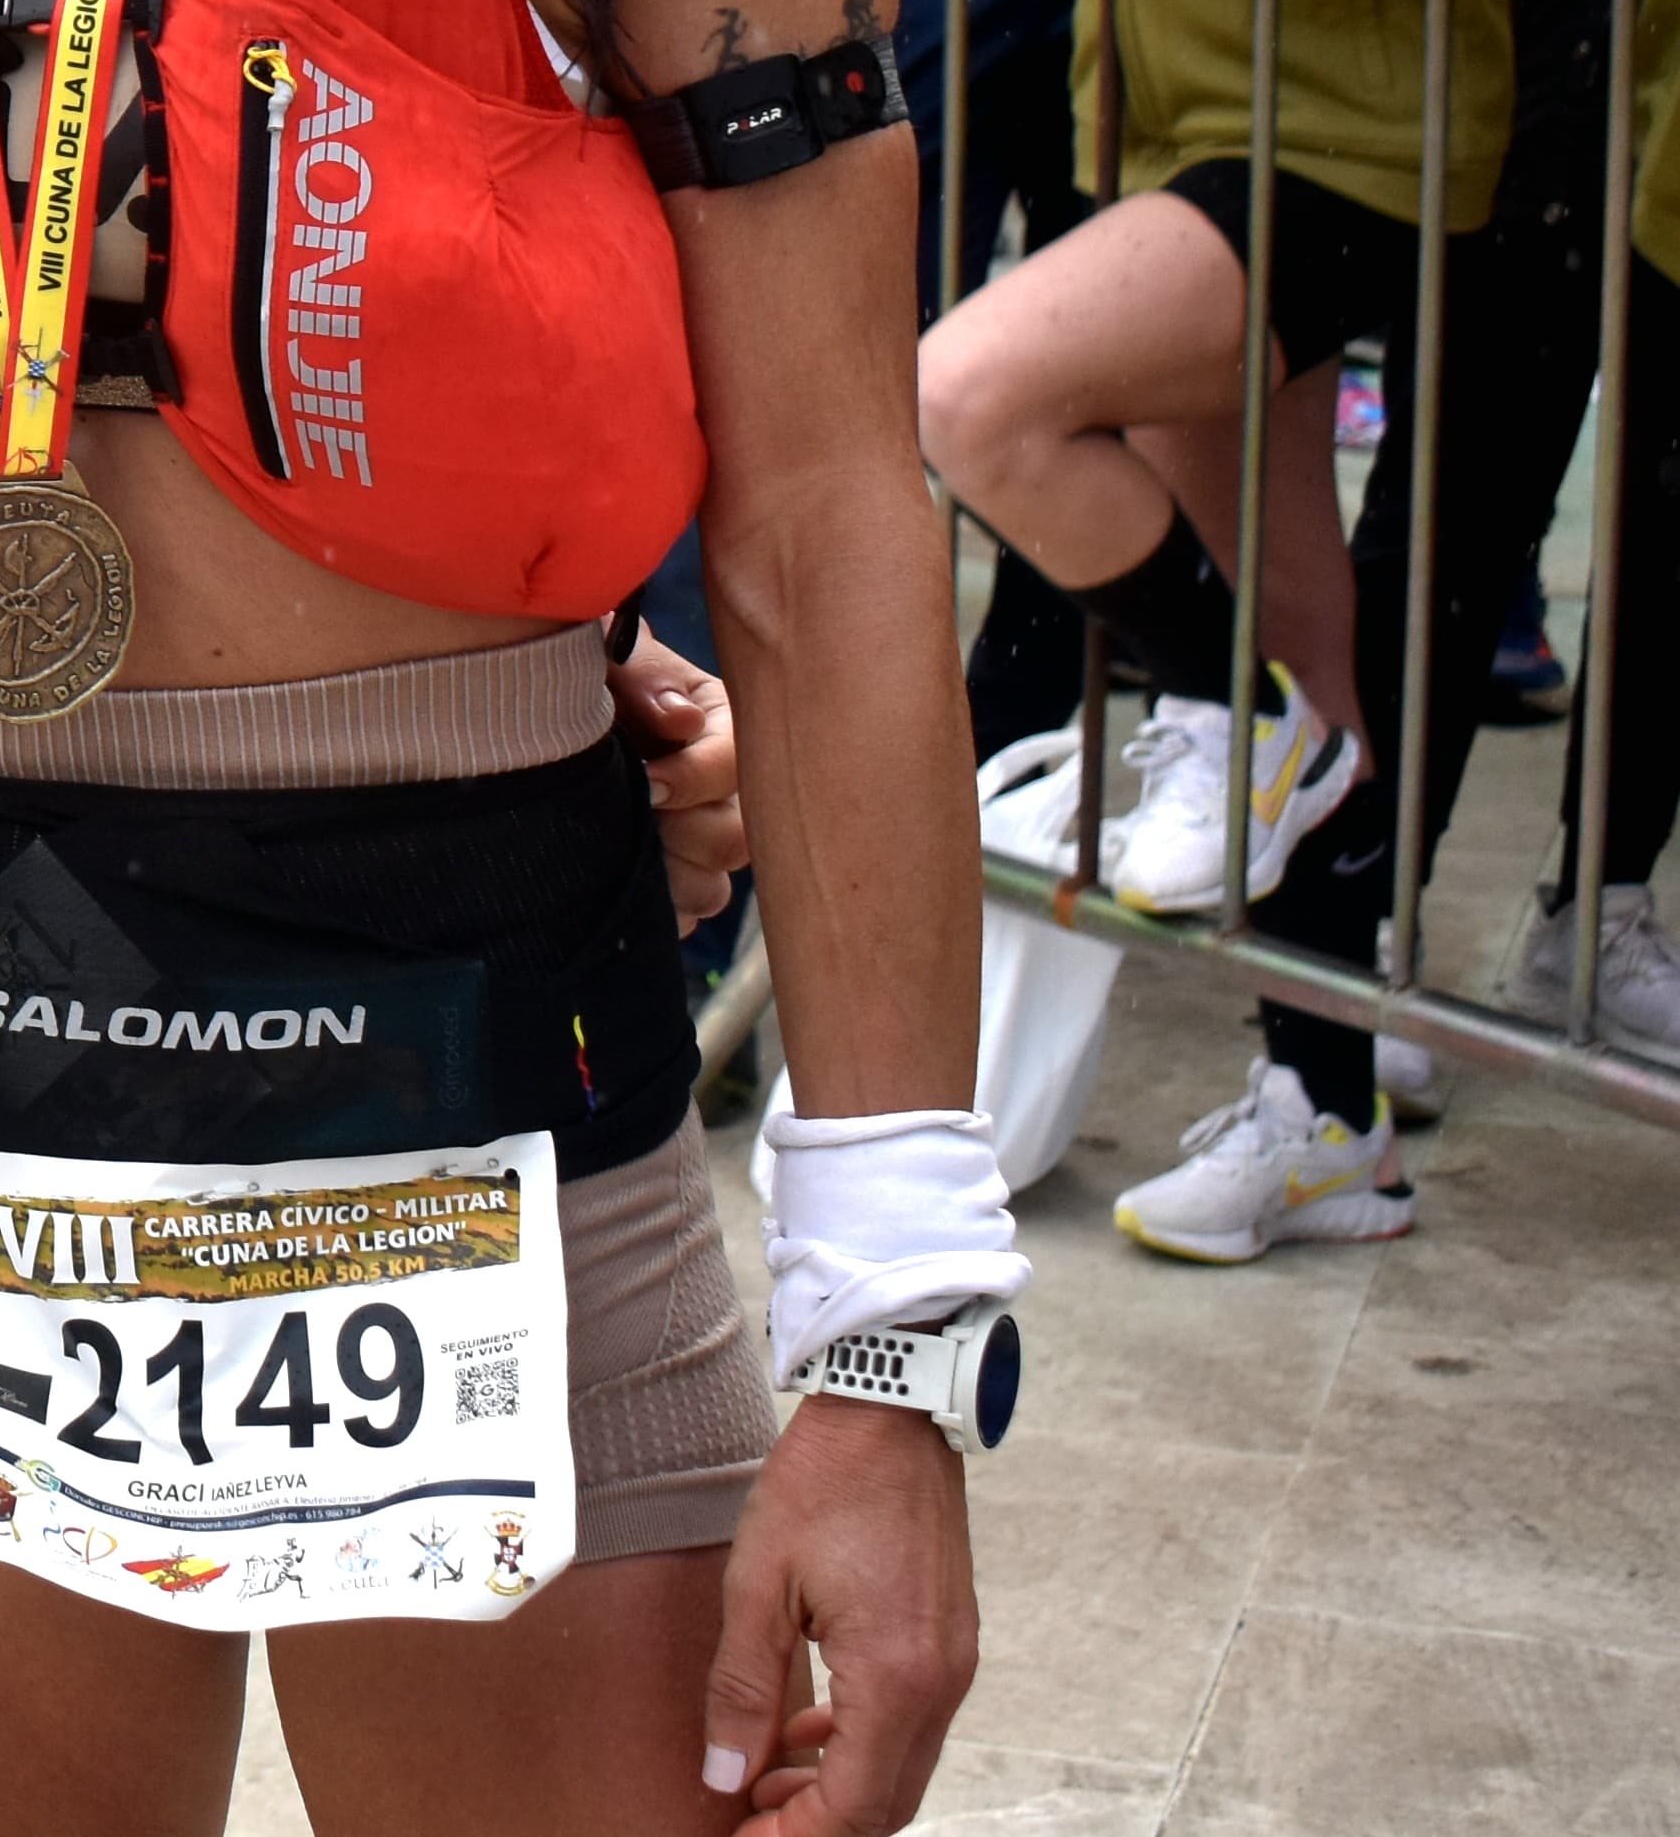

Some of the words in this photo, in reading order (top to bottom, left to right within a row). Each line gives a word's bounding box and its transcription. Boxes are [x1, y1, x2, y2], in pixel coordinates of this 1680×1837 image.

[61, 76, 89, 113] LA
[55, 120, 83, 161] DE
[44, 165, 76, 245] CUNA
[37, 249, 66, 293] VIII
[287, 57, 374, 488] AONIJIE
[52, 673, 84, 702] DE
[86, 648, 112, 675] LA
[143, 1209, 274, 1239] CARRERA
[280, 1200, 370, 1228] CÍVICO
[394, 1189, 508, 1220] MILITAR
[276, 1237, 309, 1259] DE
[316, 1232, 353, 1255] LA
[228, 1266, 331, 1295] MARCHA
[336, 1260, 383, 1284] 50,5
[389, 1254, 427, 1278] KM
[440, 1328, 530, 1355] SEGUIMIENTO
[455, 1351, 475, 1362] EN
[477, 1342, 515, 1358] VIVO
[57, 1301, 425, 1466] 2149
[127, 1479, 205, 1503] GRACI
[255, 1473, 308, 1494] LEYVA
